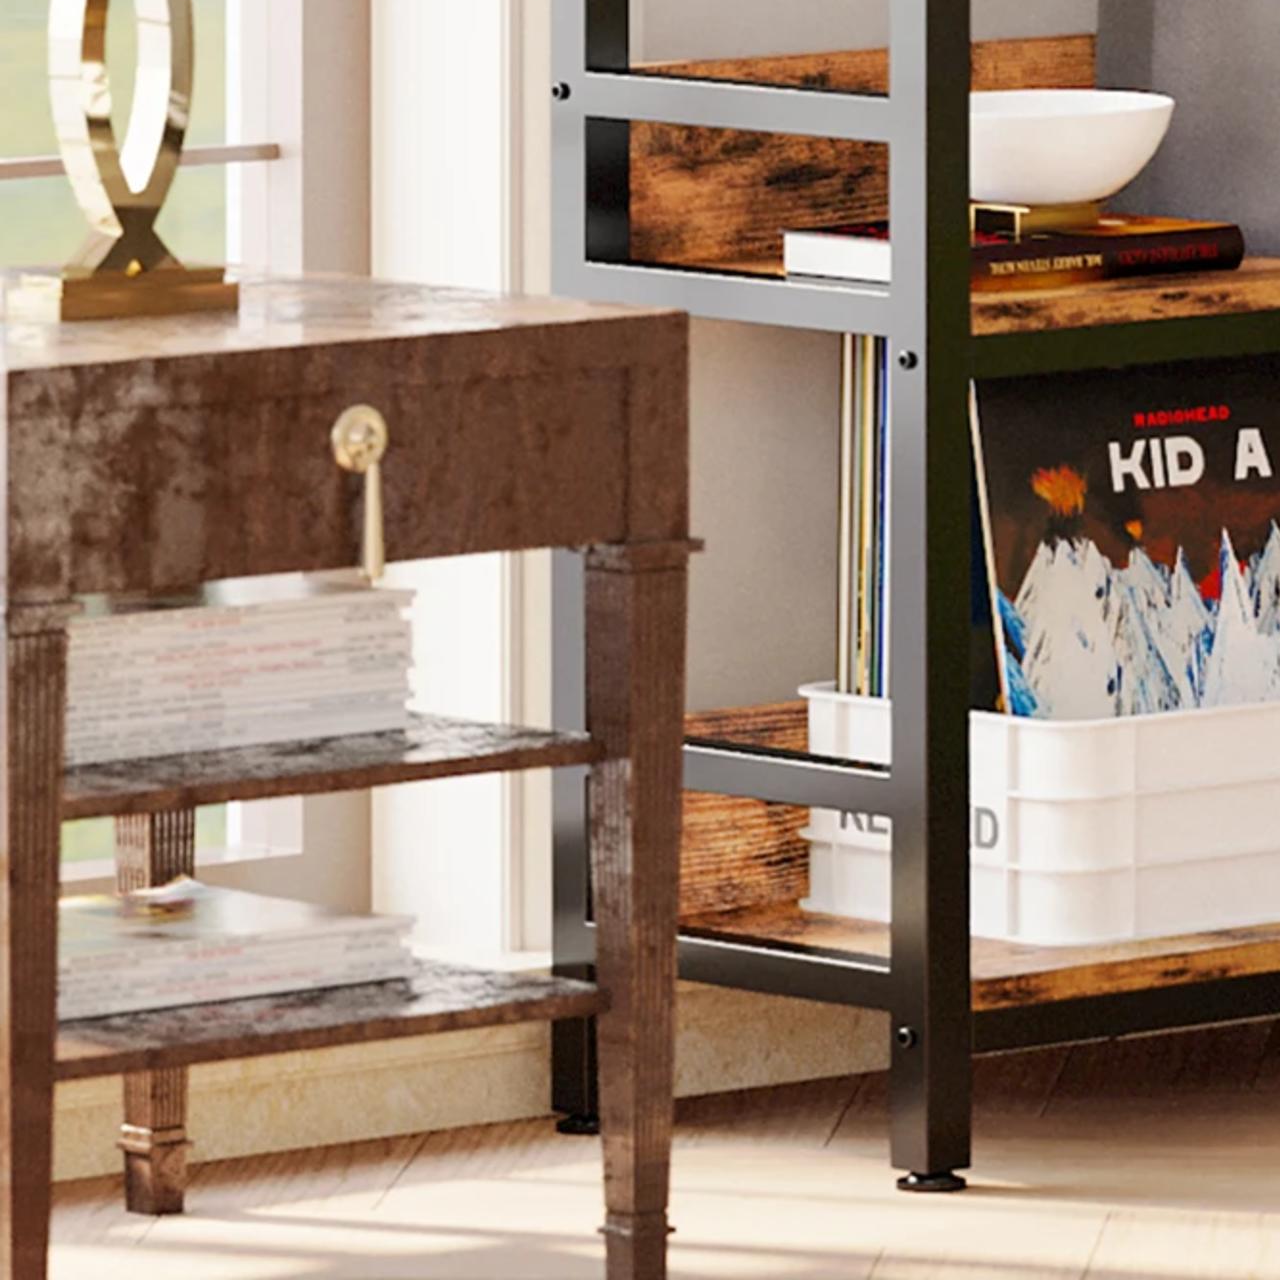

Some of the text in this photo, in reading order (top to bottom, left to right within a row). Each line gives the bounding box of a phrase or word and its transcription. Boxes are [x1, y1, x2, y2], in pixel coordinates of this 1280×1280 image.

[1134, 405, 1230, 427] RADIOHEAD
[1108, 427, 1272, 492] KID A
